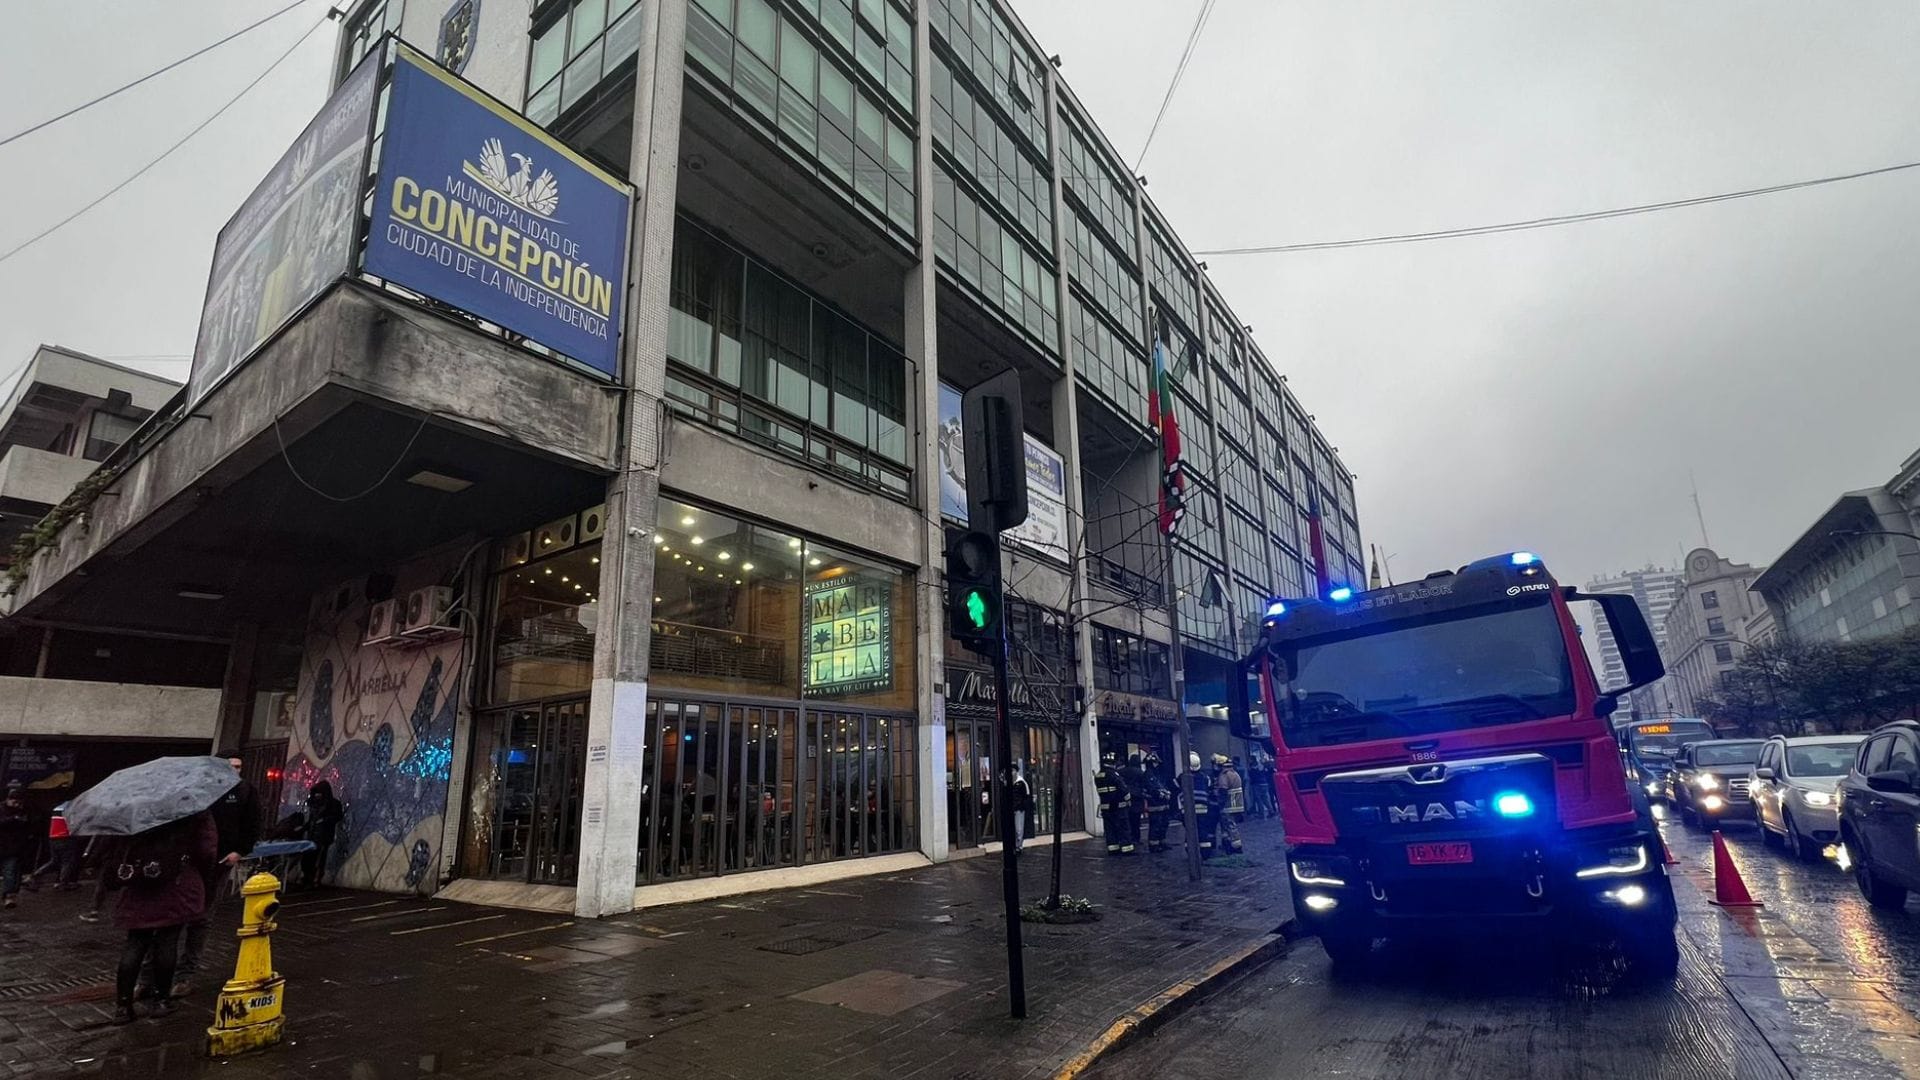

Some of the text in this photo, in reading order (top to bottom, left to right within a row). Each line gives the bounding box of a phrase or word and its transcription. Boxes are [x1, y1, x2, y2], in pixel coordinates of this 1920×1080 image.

[446, 176, 580, 261] MUNICIPALIDAD DE
[391, 176, 612, 316] CONCEPCIÓN
[386, 224, 608, 340] CIUDAD DE LA INDEPENDENCIA
[821, 577, 846, 588] ESTILO
[1398, 583, 1453, 603] LABOR
[843, 683, 853, 692] OF
[959, 671, 1031, 705] Marlla
[1412, 751, 1437, 761] 1886
[1388, 799, 1485, 824] MAN
